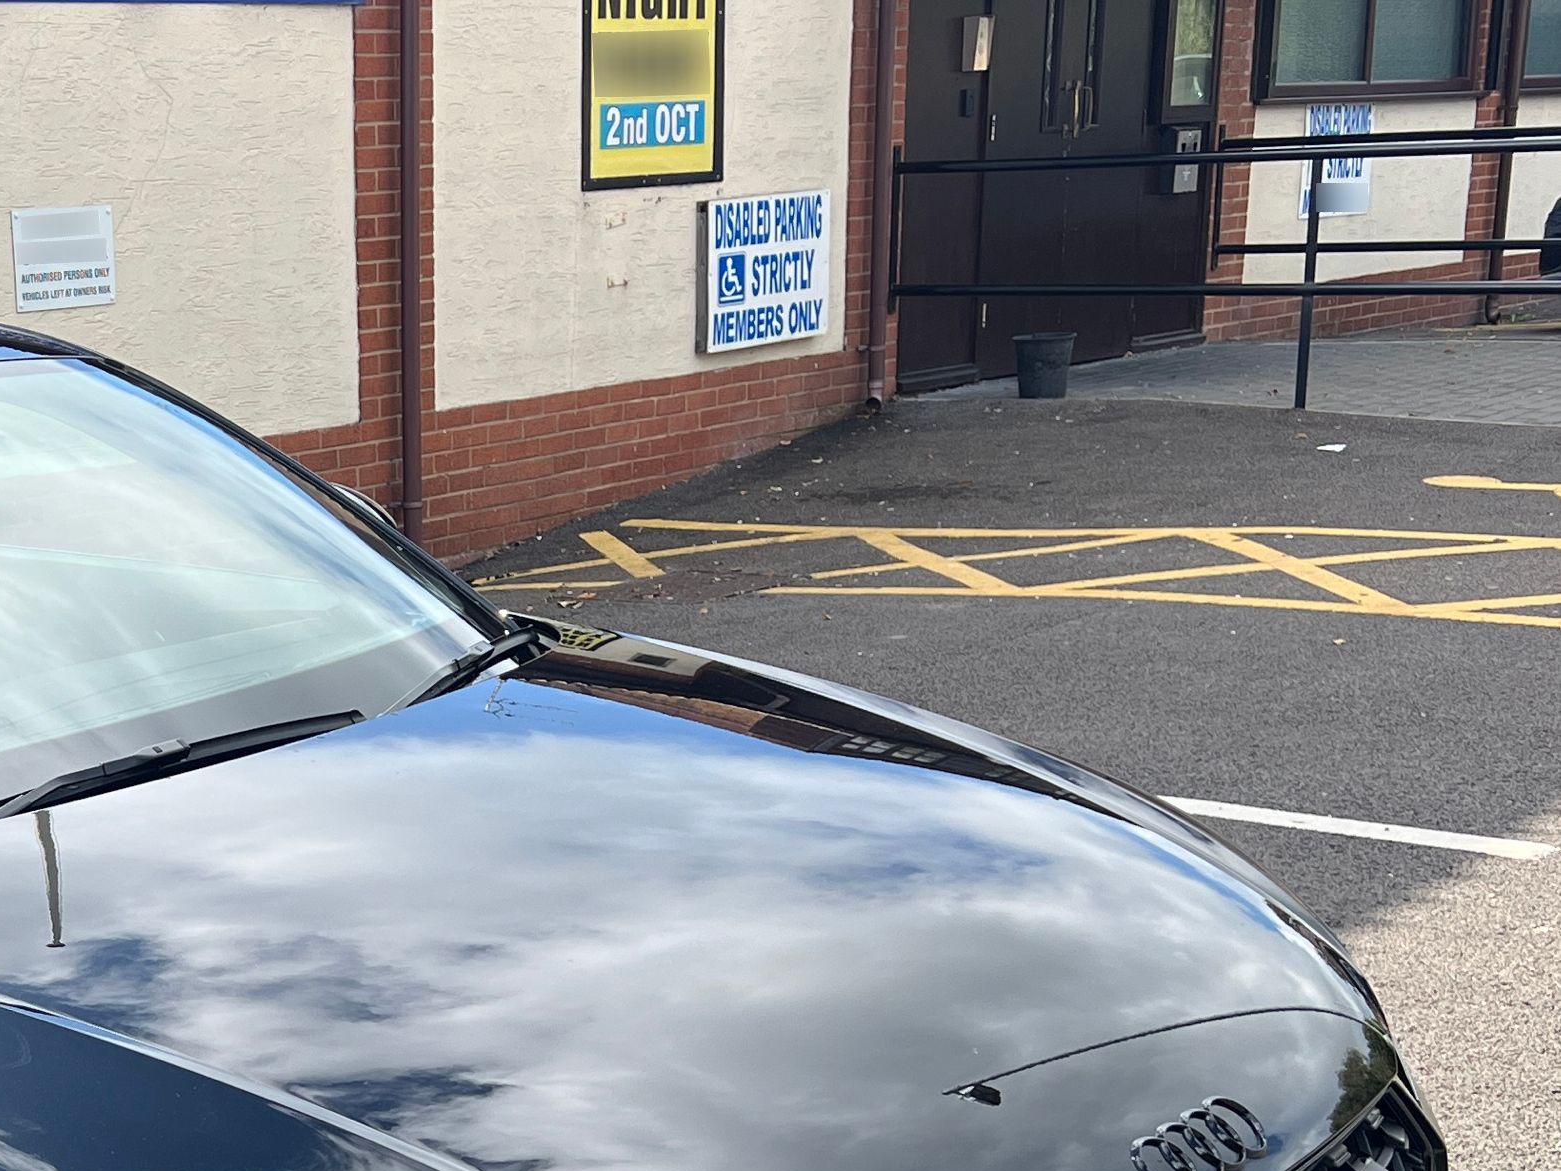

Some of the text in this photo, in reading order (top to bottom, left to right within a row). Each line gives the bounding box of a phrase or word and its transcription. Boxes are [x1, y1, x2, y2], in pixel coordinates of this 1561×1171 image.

[606, 103, 700, 146] 2nd OCT
[715, 194, 822, 249] DISABLED PARKING
[22, 267, 110, 284] AUTHORISED PERSONS ONLY
[22, 285, 111, 301] VEHICLES LEFT AT OWNERS RISK
[751, 249, 815, 297] STRICTLY
[712, 299, 823, 345] MEMBERS ONLY
